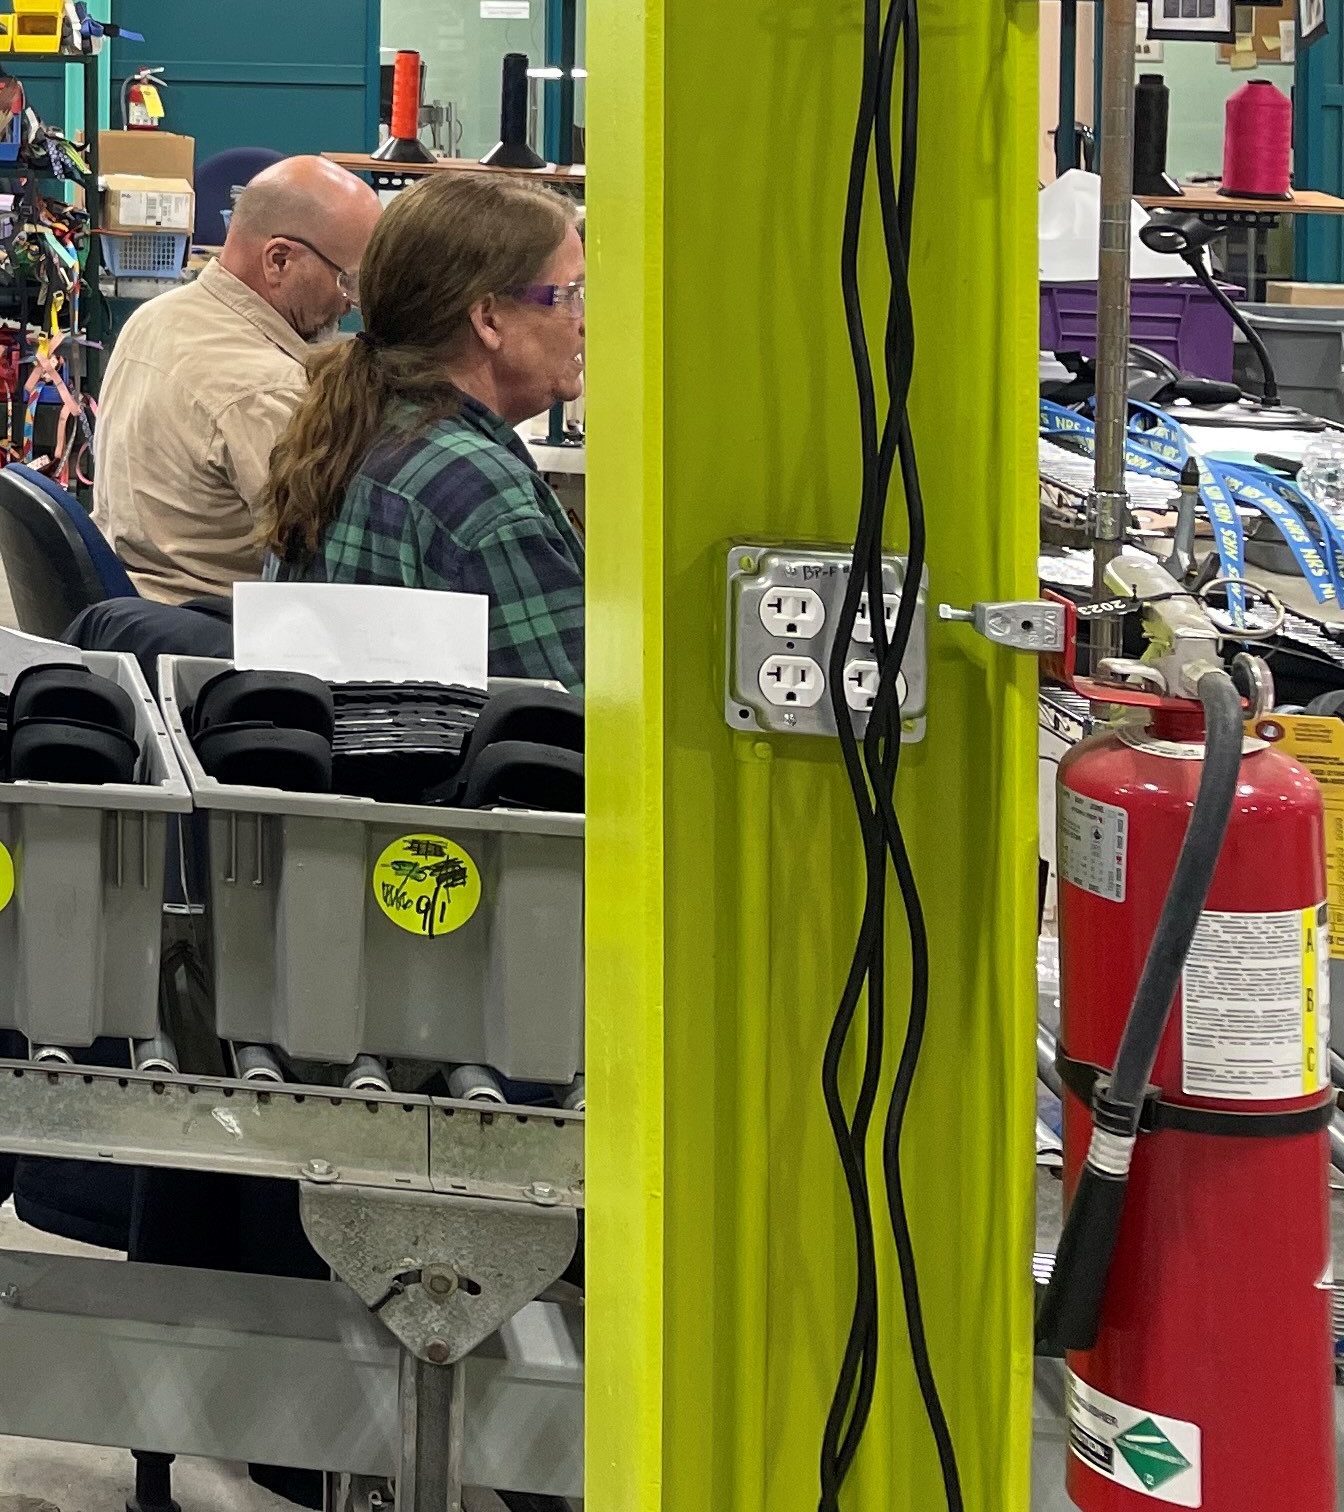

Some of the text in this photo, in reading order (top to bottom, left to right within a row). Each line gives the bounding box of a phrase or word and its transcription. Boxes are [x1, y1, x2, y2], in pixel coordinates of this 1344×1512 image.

[1220, 527, 1238, 561] NRS
[1299, 548, 1329, 577] NRS
[1077, 599, 1126, 615] 2023
